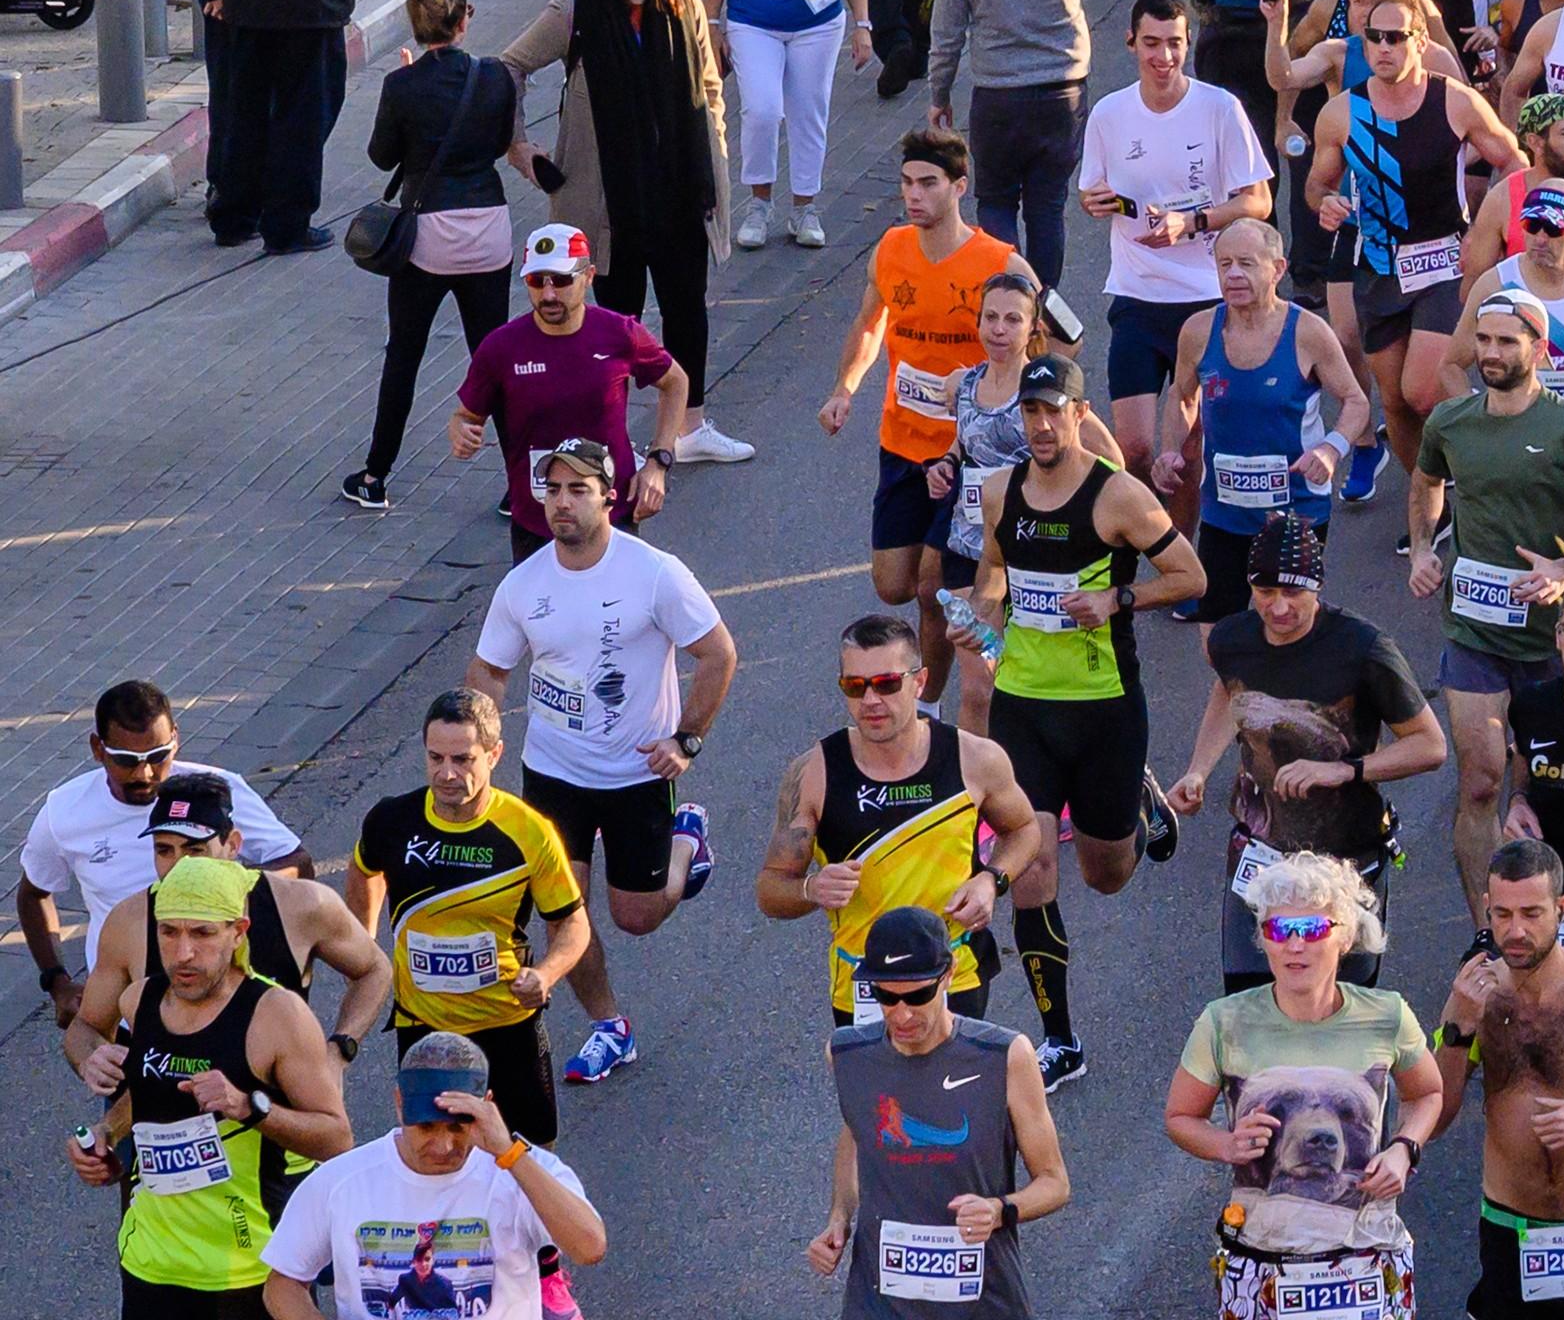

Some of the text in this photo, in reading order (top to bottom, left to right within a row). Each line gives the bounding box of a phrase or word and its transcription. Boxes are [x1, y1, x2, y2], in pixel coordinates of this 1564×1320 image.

[1414, 252, 1446, 271] 2769
[514, 360, 547, 376] tufin
[1234, 473, 1268, 490] 2288
[1023, 592, 1056, 612] 2884
[1470, 582, 1506, 605] 2760
[541, 682, 567, 709] 2324
[889, 783, 933, 801] FITNESS
[440, 844, 494, 864] FITNESS
[436, 957, 469, 973] 702
[155, 1149, 197, 1171] 1703
[912, 1234, 955, 1244] SAMSUNG
[906, 1251, 955, 1274] 3226
[1309, 1267, 1353, 1280] SAMSUNG
[1306, 1284, 1355, 1308] 1217
